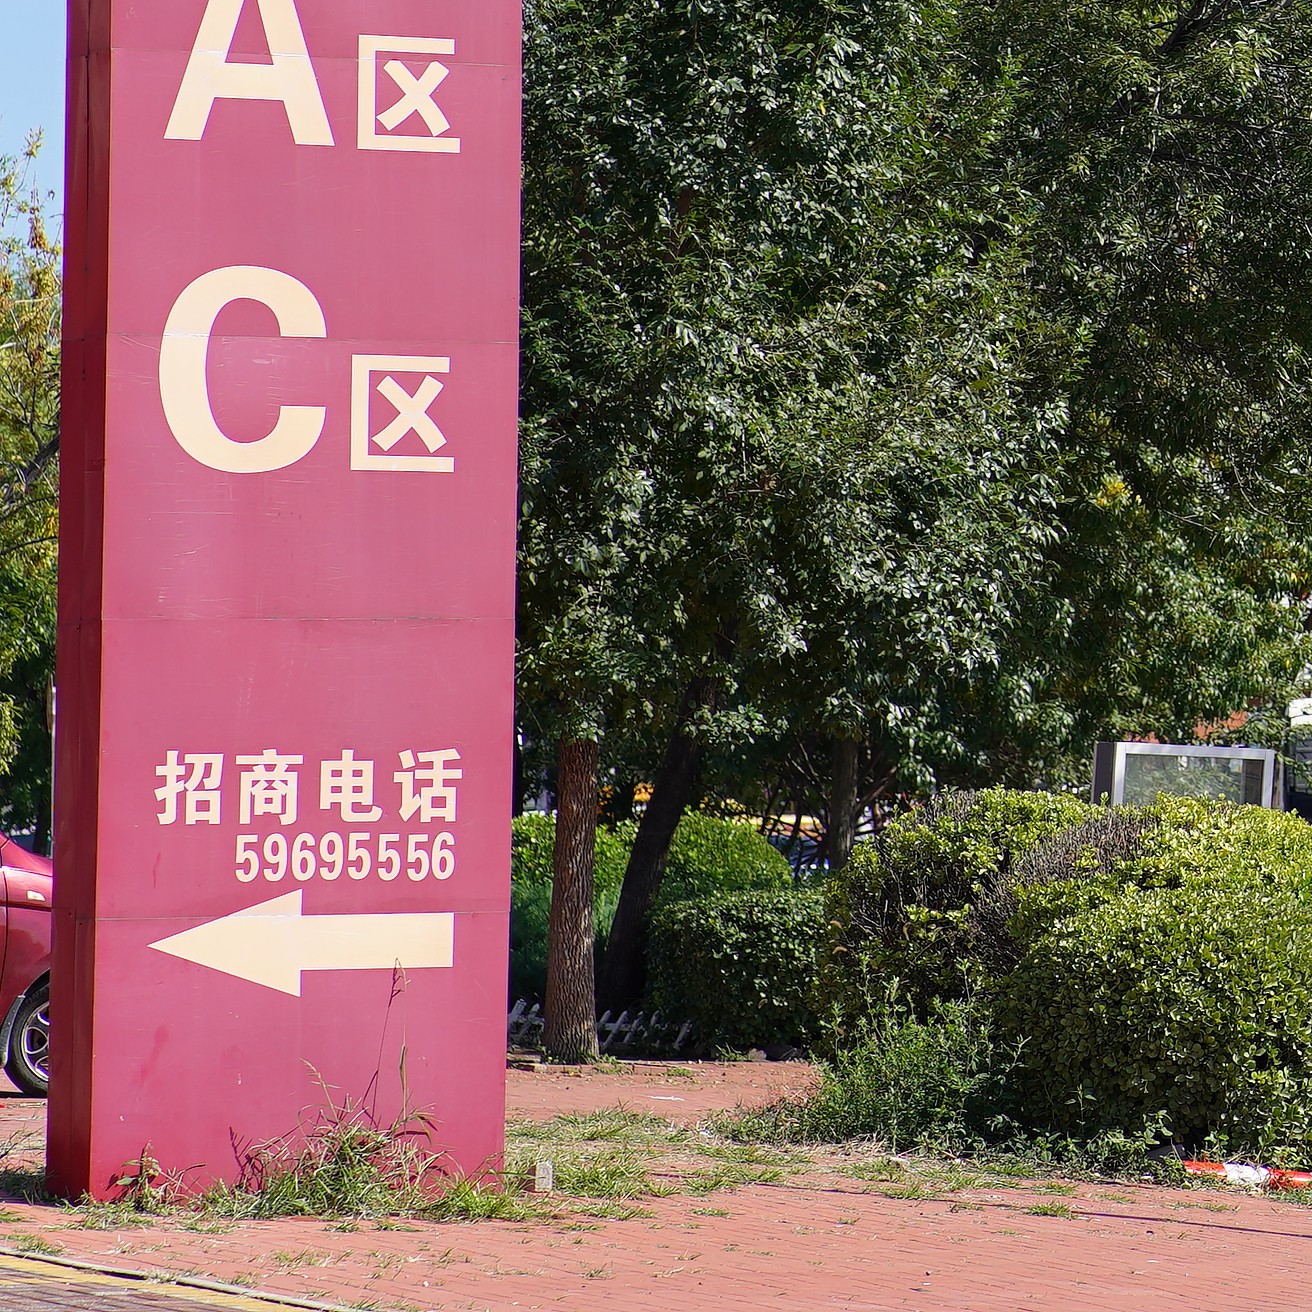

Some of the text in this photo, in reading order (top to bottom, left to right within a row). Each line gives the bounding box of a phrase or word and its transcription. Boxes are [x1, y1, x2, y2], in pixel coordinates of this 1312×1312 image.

[154, 748, 463, 825] 招商电话
[234, 831, 456, 883] 59695556
